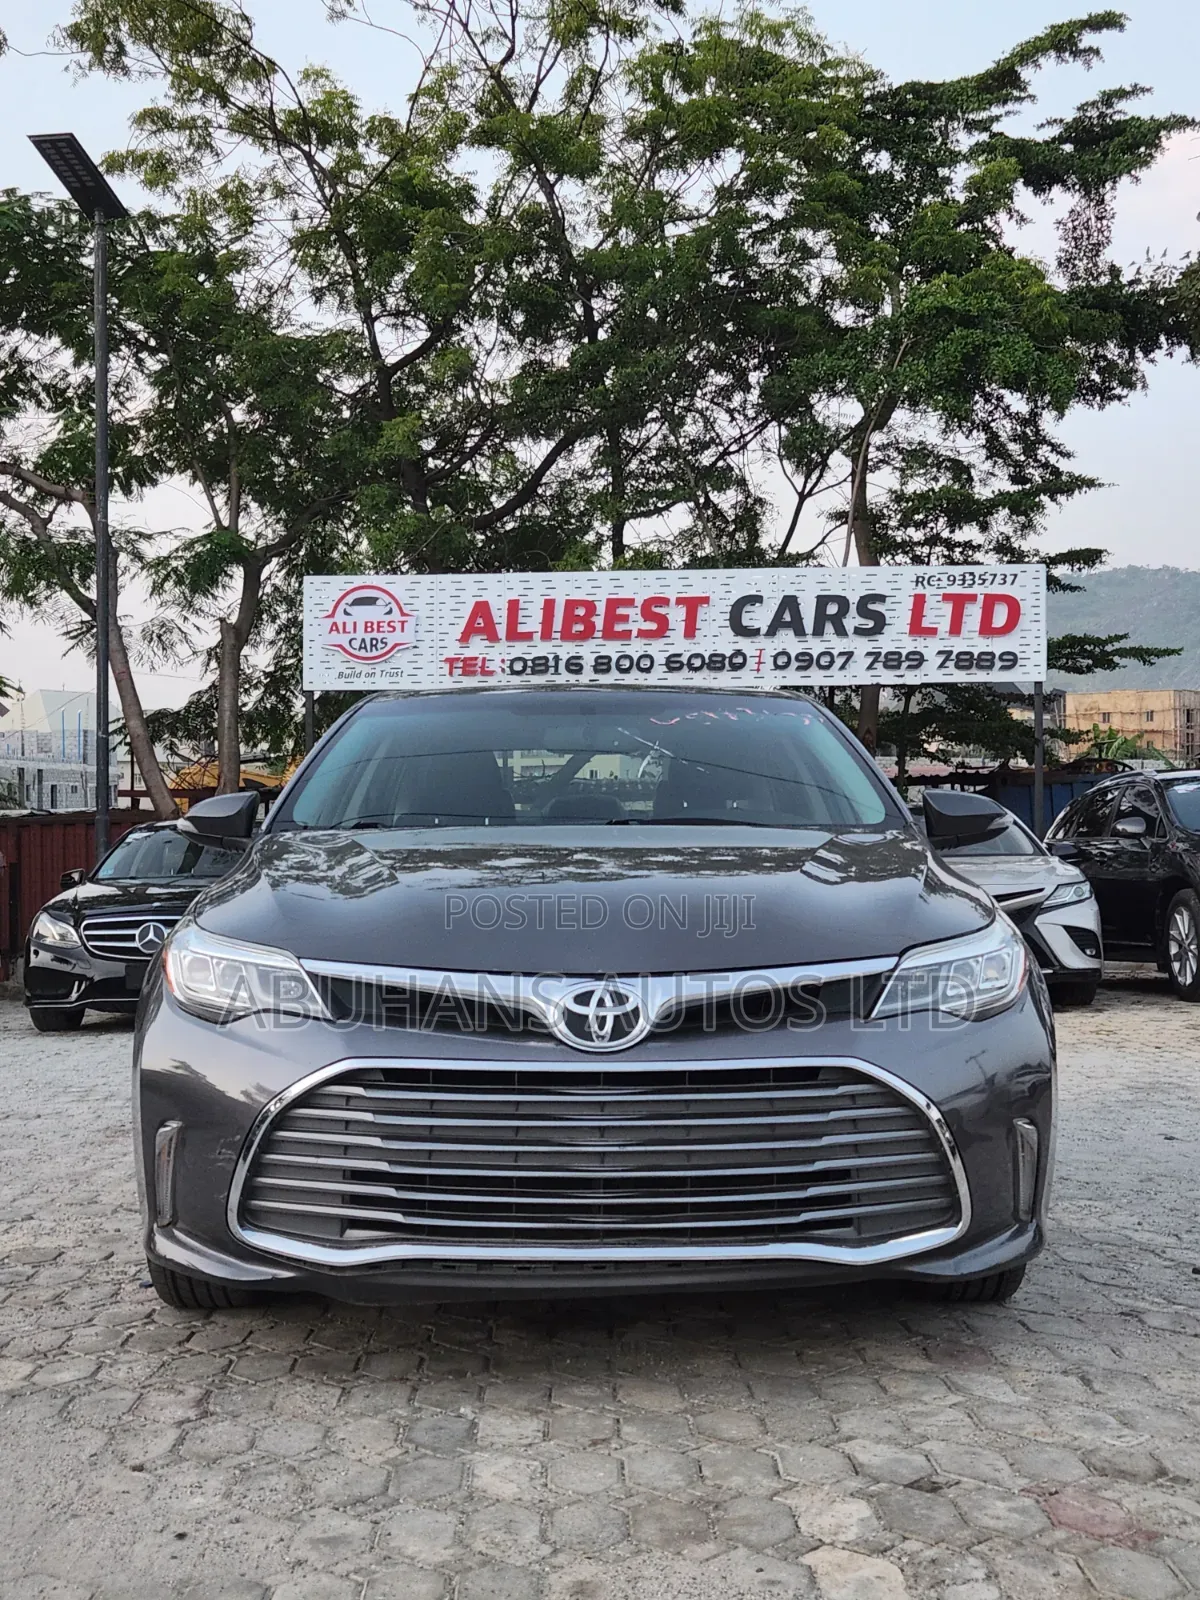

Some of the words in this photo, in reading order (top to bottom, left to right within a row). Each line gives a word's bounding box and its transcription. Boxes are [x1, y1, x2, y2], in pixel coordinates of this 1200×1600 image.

[947, 573, 1018, 587] 9335737
[459, 595, 710, 644] ALIBEST
[729, 594, 887, 639] CARS
[908, 593, 1021, 637] LTD
[328, 621, 357, 634] ALI
[364, 620, 408, 633] BEST
[348, 637, 388, 653] CARS
[509, 655, 584, 676] 0816
[593, 653, 654, 674] 800
[665, 651, 747, 673] 6080
[773, 650, 854, 671] 0907
[864, 650, 925, 671] 789
[936, 650, 1019, 670] 7889
[337, 670, 362, 679] Build
[364, 671, 376, 679] on
[380, 669, 404, 678] Trust
